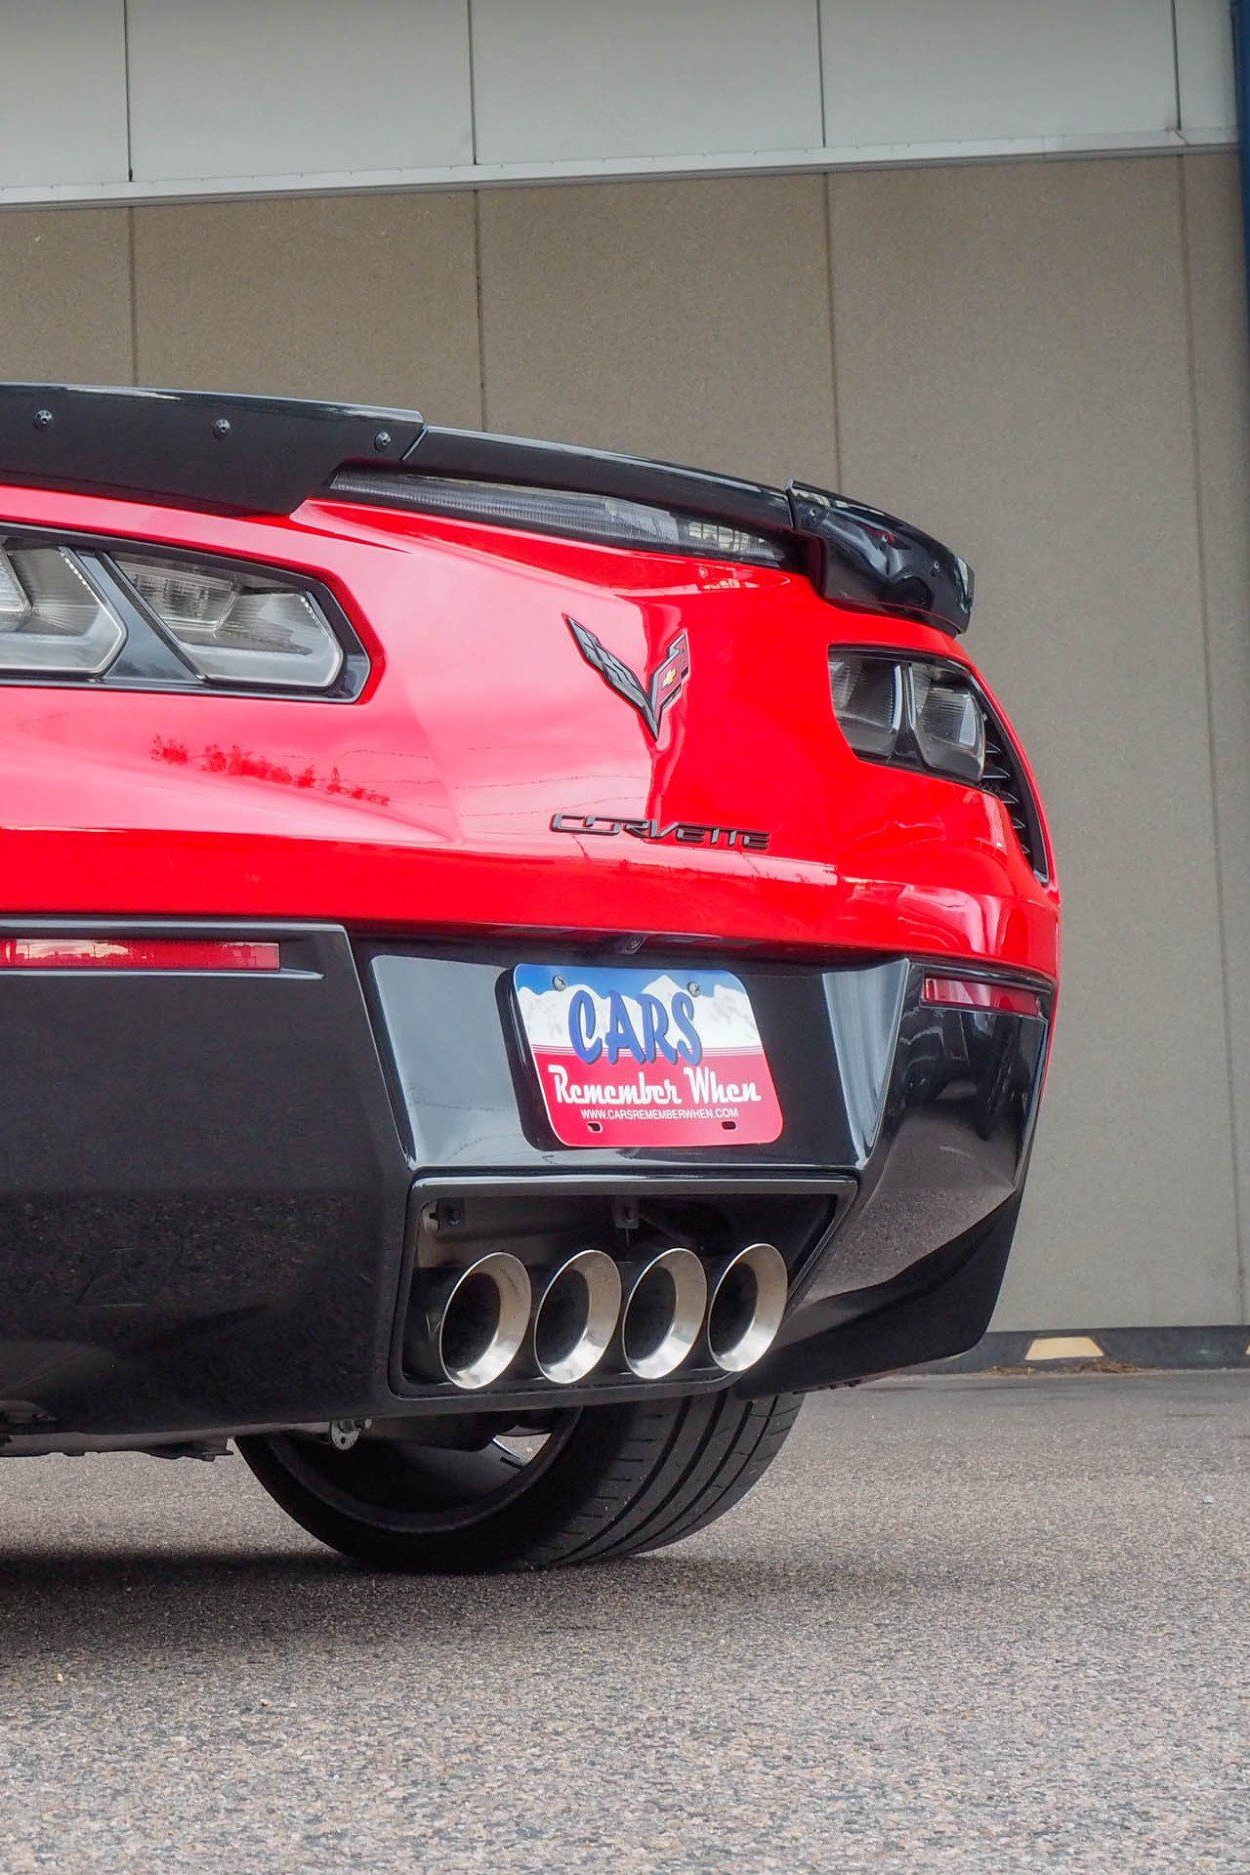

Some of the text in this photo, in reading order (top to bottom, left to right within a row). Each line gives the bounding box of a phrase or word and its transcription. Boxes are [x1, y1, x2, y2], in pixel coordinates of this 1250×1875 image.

[550, 813, 769, 850] CORVETTE
[568, 989, 703, 1065] CARS
[549, 1064, 762, 1105] Remember When
[581, 1108, 739, 1121] WWW.CARSREMEMBERWHEN.COM
